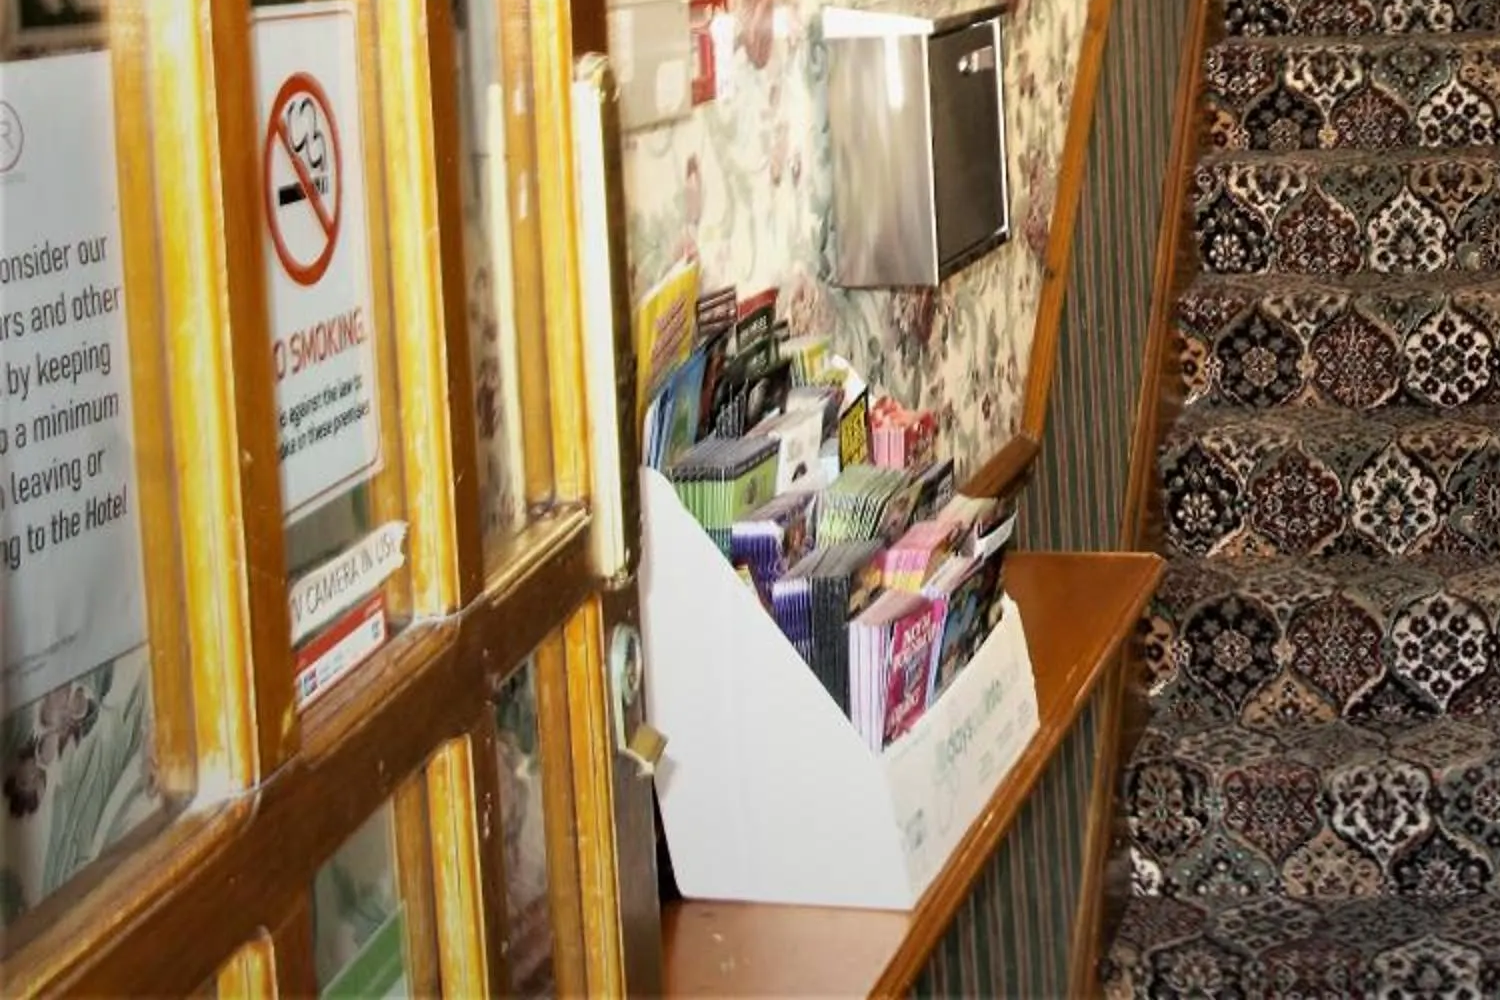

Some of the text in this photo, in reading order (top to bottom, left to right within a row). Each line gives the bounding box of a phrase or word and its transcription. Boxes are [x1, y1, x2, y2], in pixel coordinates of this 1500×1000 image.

[78, 236, 107, 266] our
[31, 291, 66, 333] and
[72, 284, 121, 320] other
[289, 307, 368, 374] SMOKING
[8, 341, 111, 401] by keeping
[15, 423, 27, 450] a
[33, 392, 119, 442] minimum
[11, 457, 82, 505] leaving
[87, 448, 106, 478] or
[28, 523, 45, 554] to
[51, 507, 81, 546] the
[85, 484, 128, 531] Hotel
[305, 557, 357, 615] CAMERA
